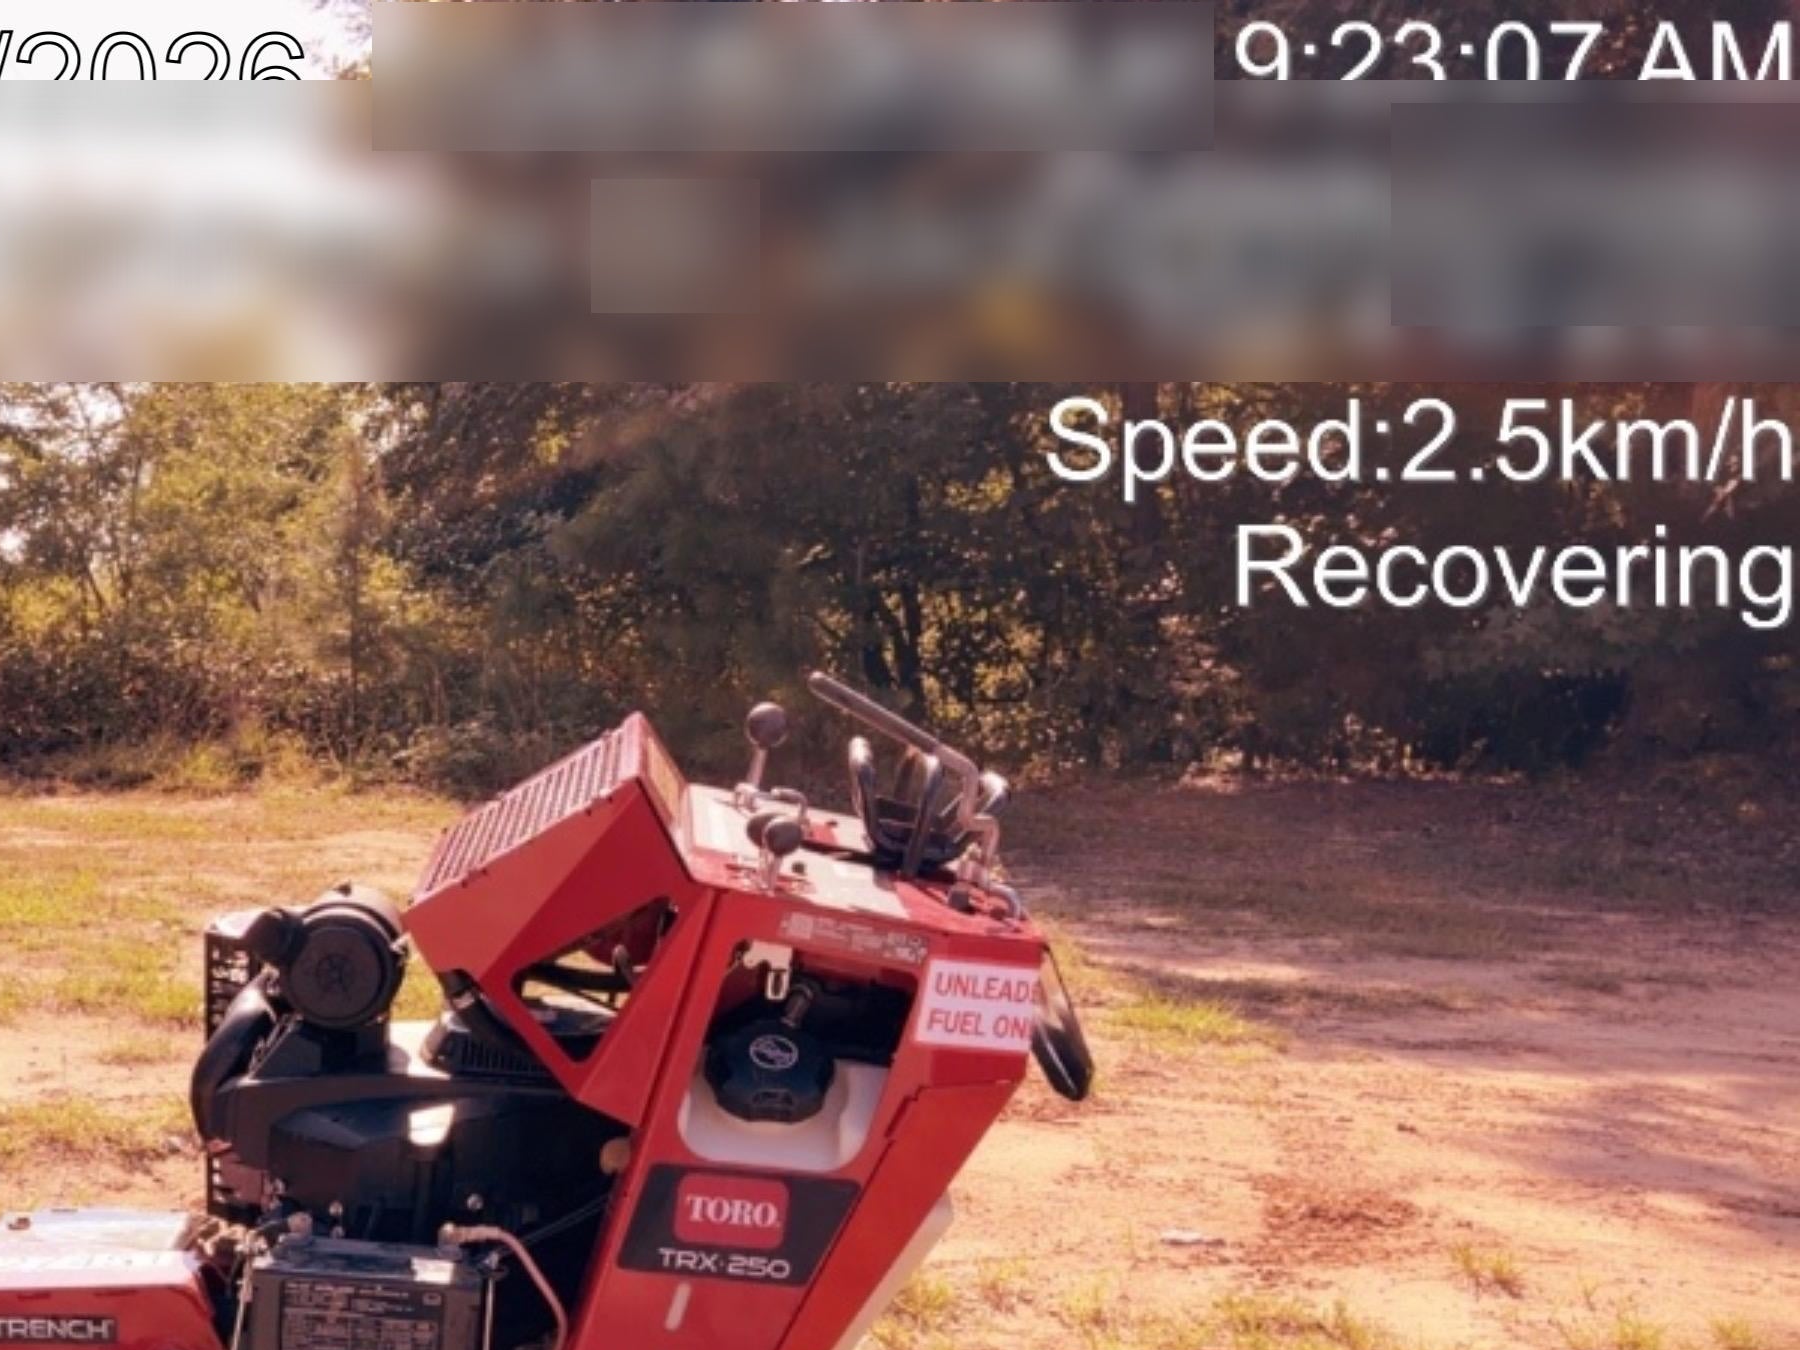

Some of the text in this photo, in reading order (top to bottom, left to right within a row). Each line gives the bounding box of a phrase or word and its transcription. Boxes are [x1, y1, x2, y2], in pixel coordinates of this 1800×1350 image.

[927, 1008, 1033, 1039] FUEL ON
[687, 1194, 779, 1228] TORO
